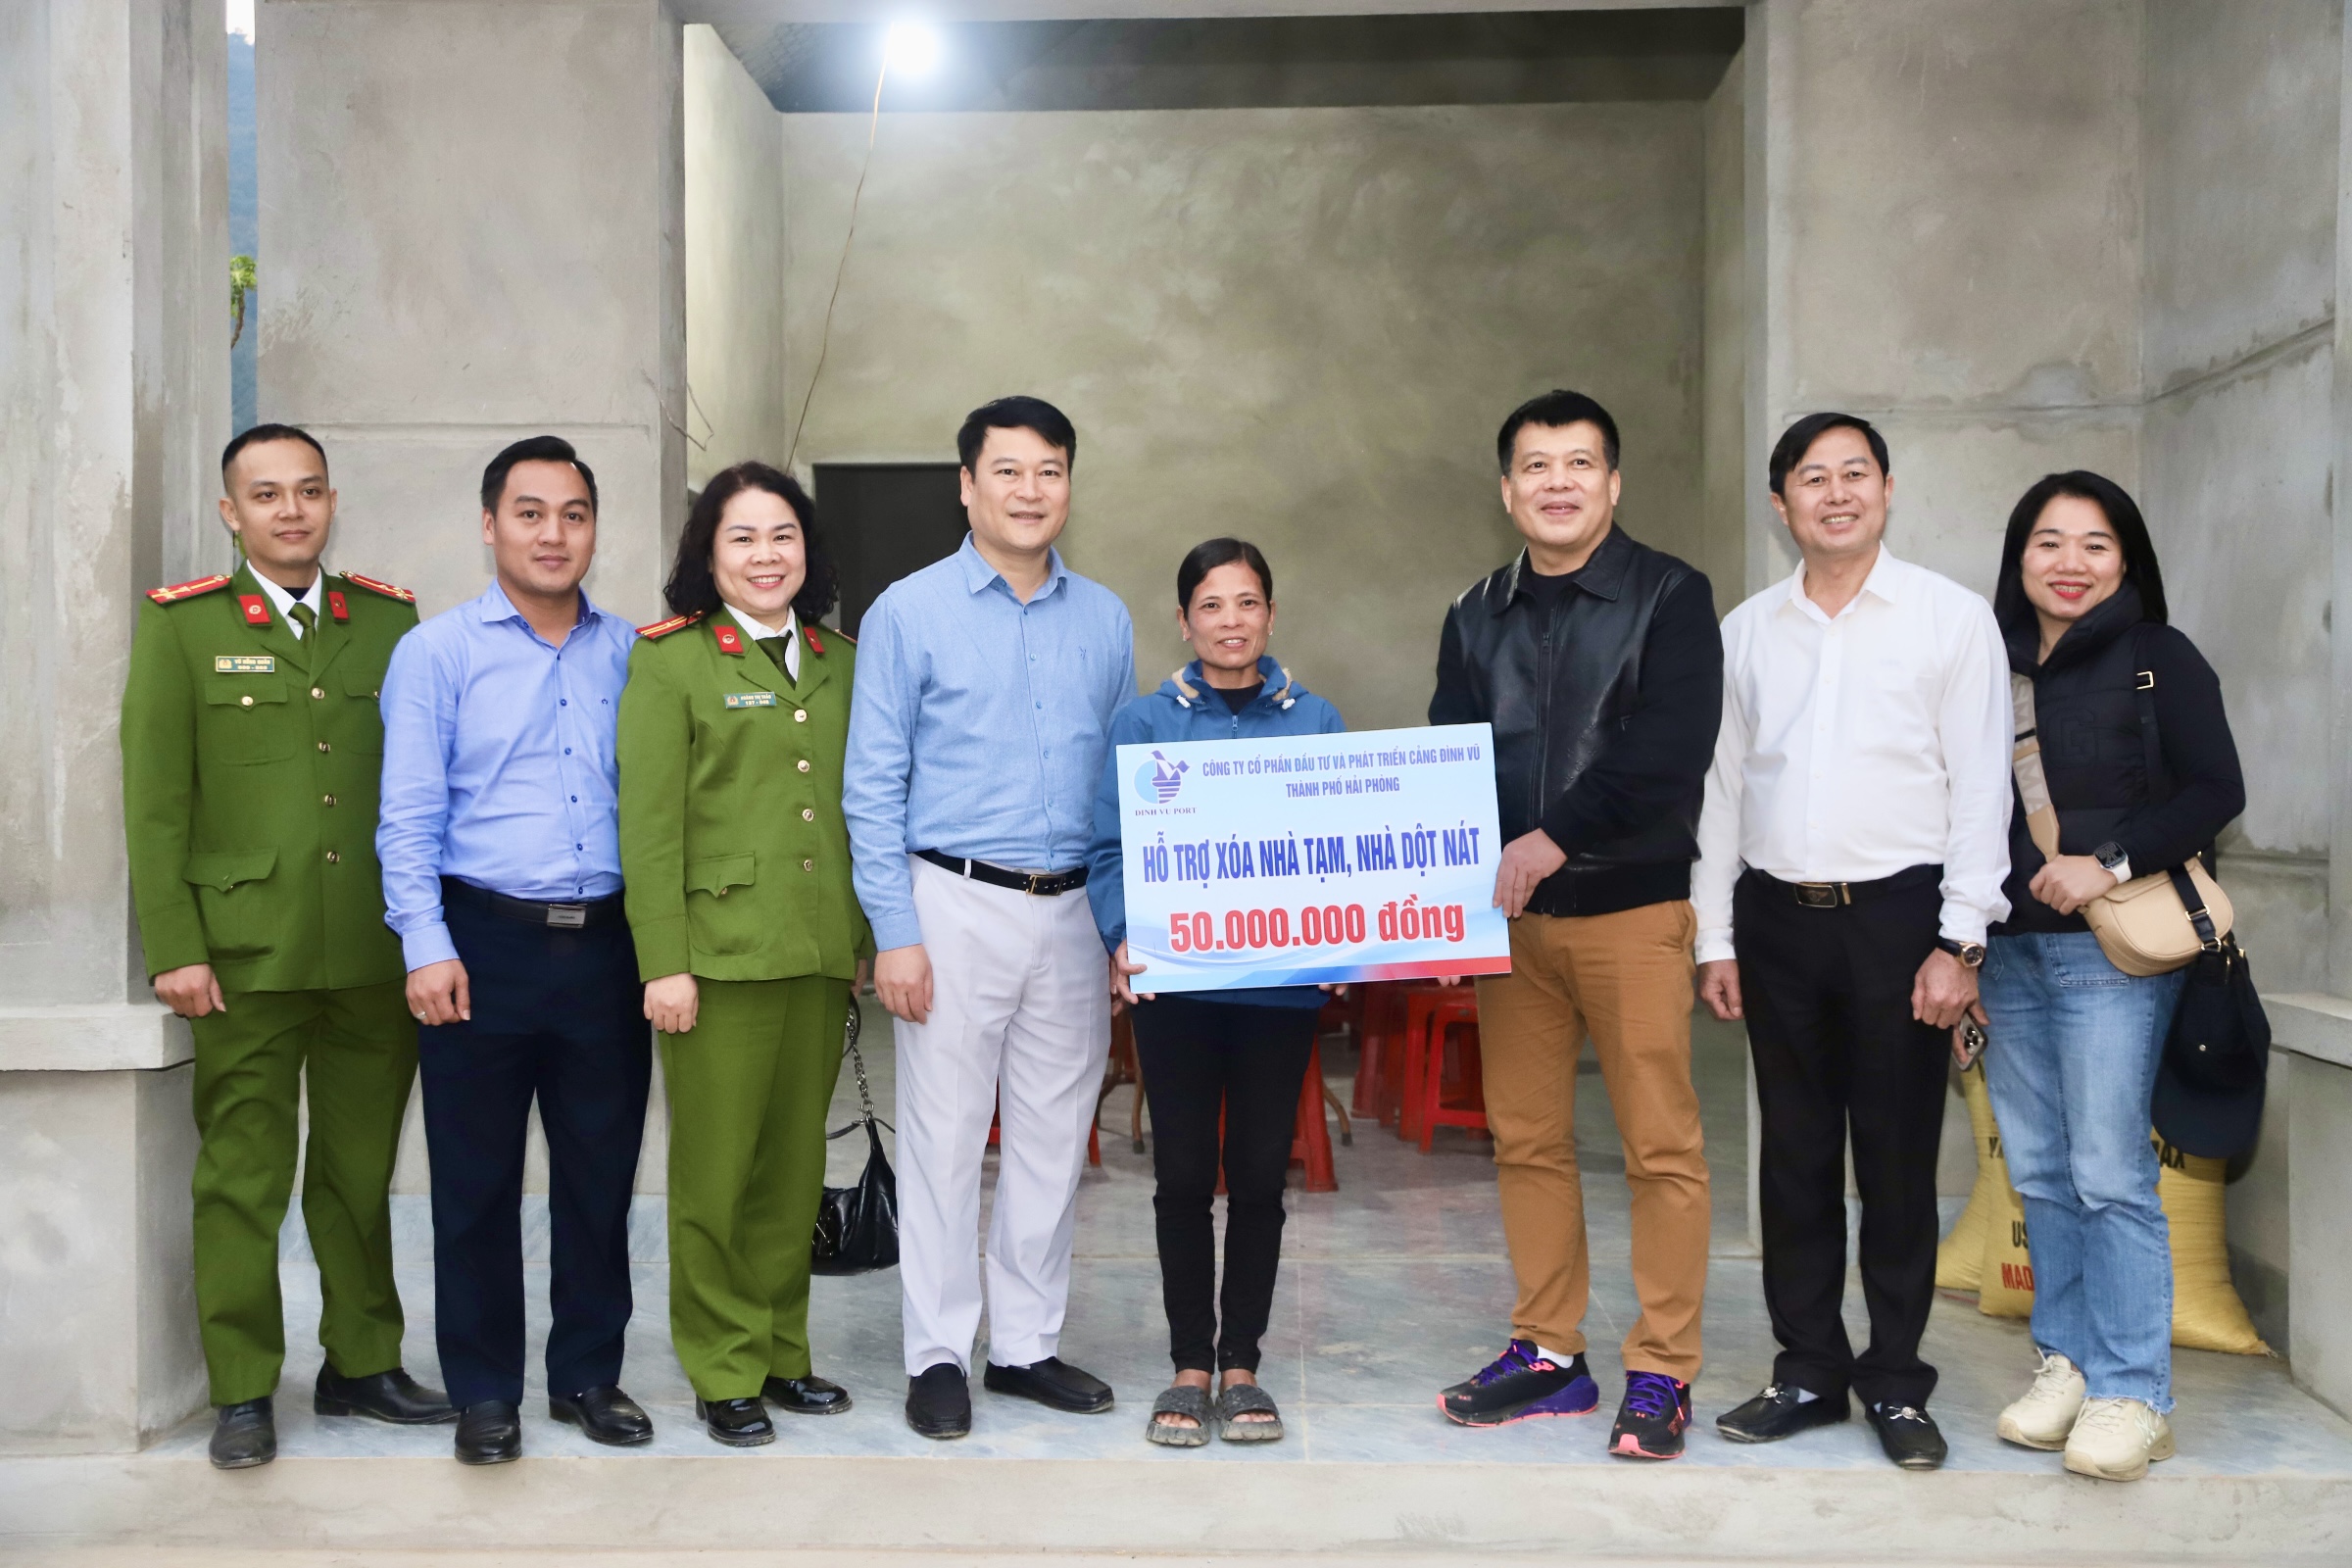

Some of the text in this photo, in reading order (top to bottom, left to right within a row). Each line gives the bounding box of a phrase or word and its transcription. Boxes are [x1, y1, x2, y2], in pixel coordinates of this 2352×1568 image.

[1202, 744, 1481, 777] CÔNG TY CỔ PHẦN ĐẦU TƯ VÀ PHÁT TRIỂN CẢNG ĐÌNH VŨ
[1286, 774, 1400, 798] THÀNH PHỐ HẢI PHÒNG
[1173, 807, 1198, 815] PORT
[1143, 819, 1480, 889] HỖ TRỢ XÓA NHÀ TẠM, NHÀ DỘT NÁT
[1170, 894, 1465, 953] 50.000.000 đồng
